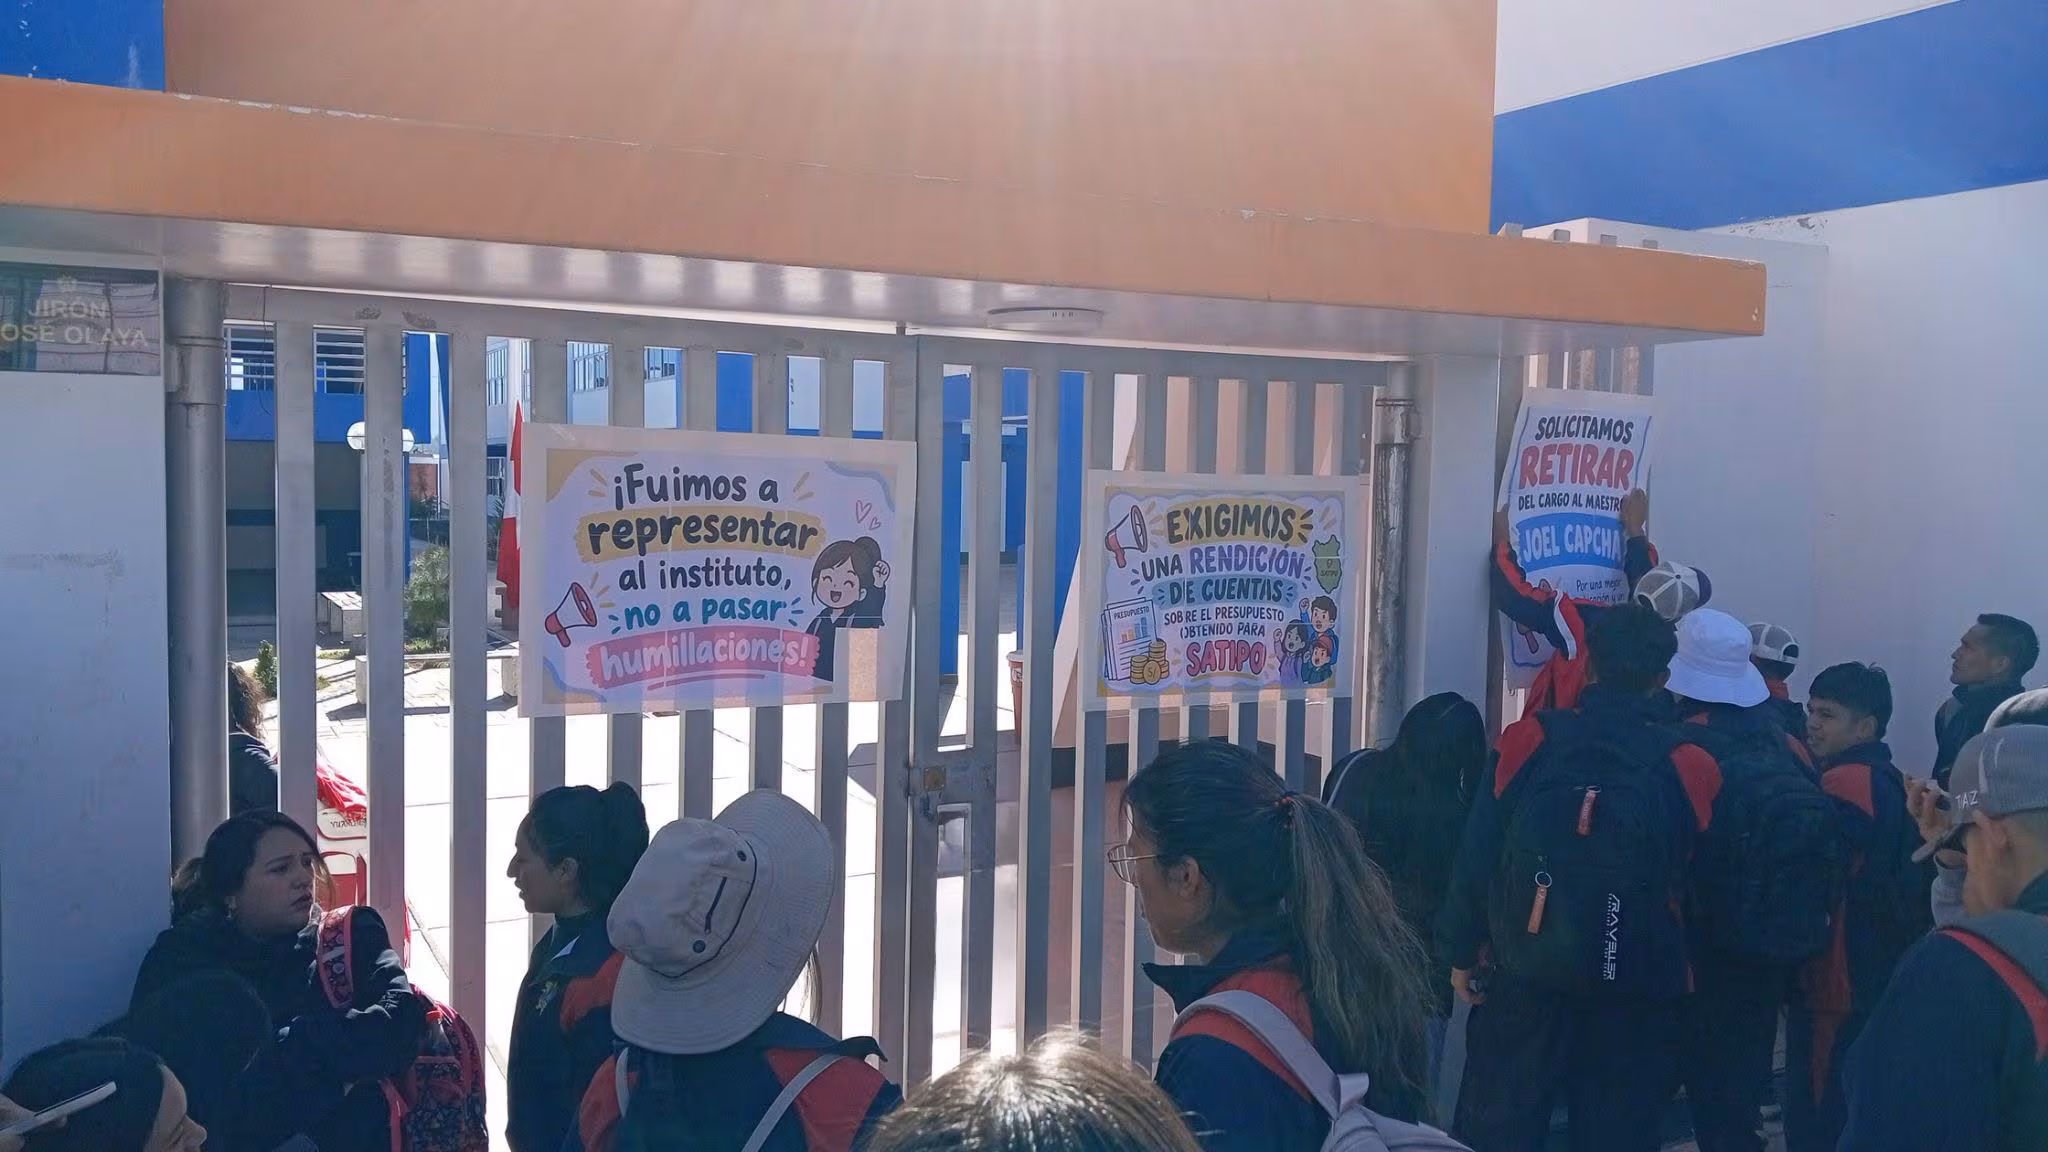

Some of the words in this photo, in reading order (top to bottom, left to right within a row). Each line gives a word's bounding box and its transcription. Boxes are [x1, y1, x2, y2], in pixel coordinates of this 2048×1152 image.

[0, 321, 55, 342] OSÉ
[64, 326, 149, 347] OLAYA
[1535, 415, 1634, 444] SOLICITAMOS
[1519, 443, 1634, 491] RETIRAR
[614, 463, 747, 511] ¡Fuimos
[758, 477, 779, 503] a
[1518, 495, 1535, 512] DEL
[1538, 492, 1570, 508] CARGO
[1571, 493, 1583, 507] AL
[588, 511, 819, 556] representar
[1167, 503, 1296, 544] EXIGIMOS
[1523, 524, 1560, 563] JOEL
[1564, 523, 1621, 562] CAPCHA
[618, 559, 646, 591] al
[660, 557, 791, 592] instituto,
[1141, 554, 1182, 582] UNA
[1189, 543, 1305, 579] RENDICIÓN
[1170, 580, 1196, 605] DE
[1201, 578, 1283, 602] CUENTAS
[624, 599, 661, 631] no
[673, 600, 691, 623] a
[702, 597, 785, 625] pasar
[1113, 605, 1150, 620] PRESUPUESTO
[1163, 609, 1197, 626] SOBRE
[1200, 609, 1212, 621] EL
[1215, 606, 1285, 623] PRESUPUESTO
[1180, 622, 1233, 639] OBTENIDO
[1237, 622, 1266, 638] PARA
[601, 631, 809, 682] humillaciones!
[1186, 640, 1268, 677] SATIPO
